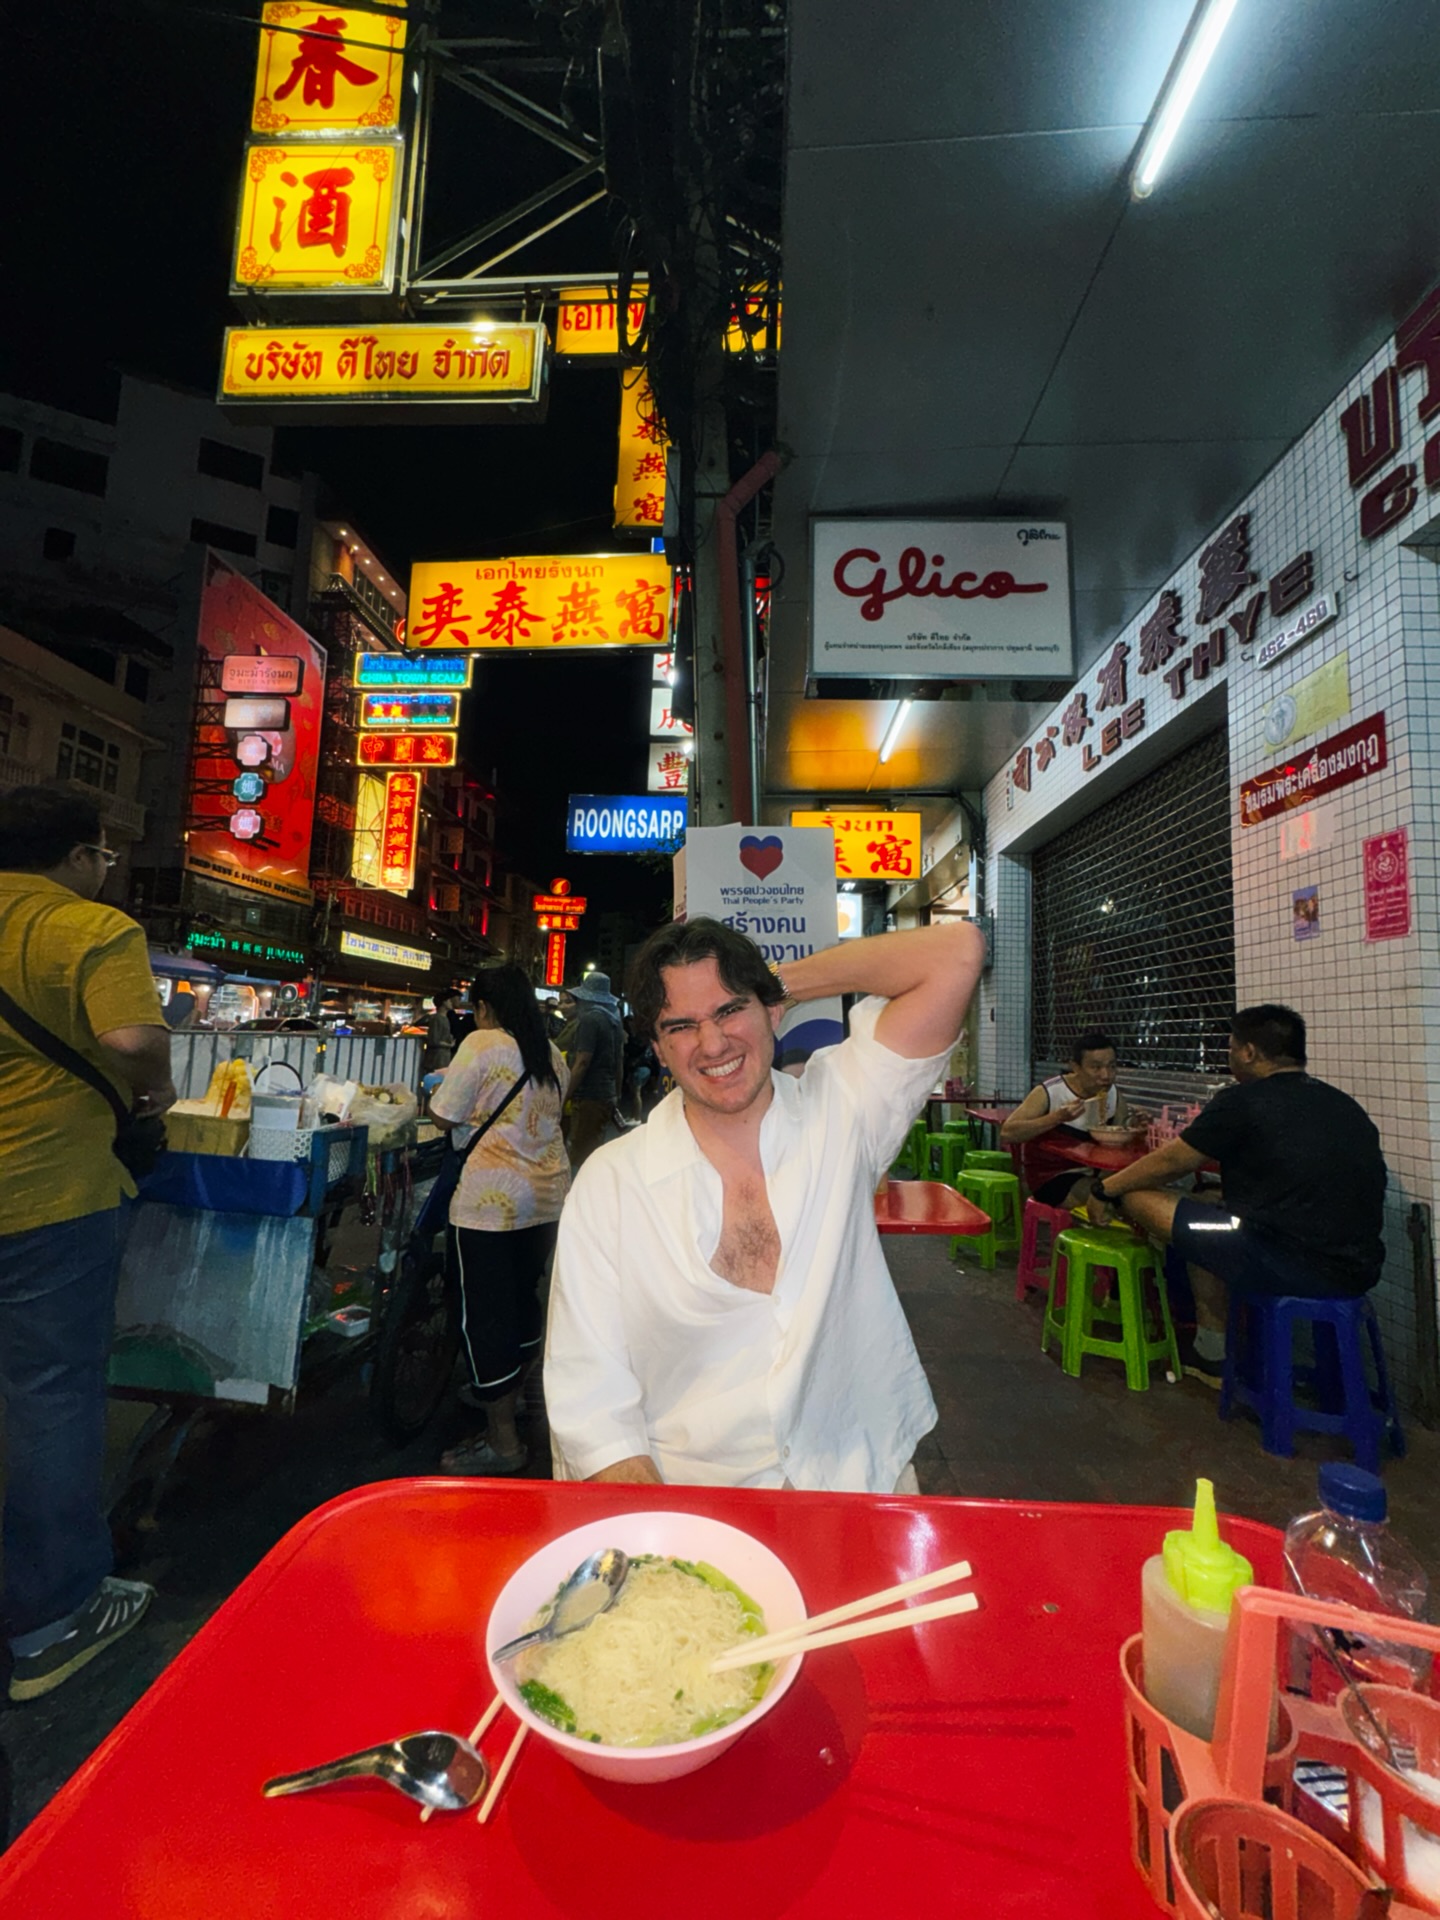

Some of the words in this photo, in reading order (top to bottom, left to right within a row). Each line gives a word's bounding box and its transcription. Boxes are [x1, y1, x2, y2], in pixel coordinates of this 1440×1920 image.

[244, 341, 323, 381] บริษัท
[336, 335, 420, 381] ดีไทย
[432, 338, 511, 380] จำกัด
[475, 561, 604, 580] เอกไทยรังนก
[833, 547, 1048, 621] Glico
[1082, 698, 1145, 771] LEE
[1163, 551, 1315, 700] THYE
[360, 673, 393, 684] CHINA
[395, 673, 428, 684] TOWN
[430, 673, 465, 684] SCALA
[573, 808, 684, 838] ROONGSARP
[720, 883, 805, 896] พรรคปวงชนไทย
[723, 897, 740, 905] Thai
[743, 897, 778, 906] People's
[781, 897, 804, 906] Party
